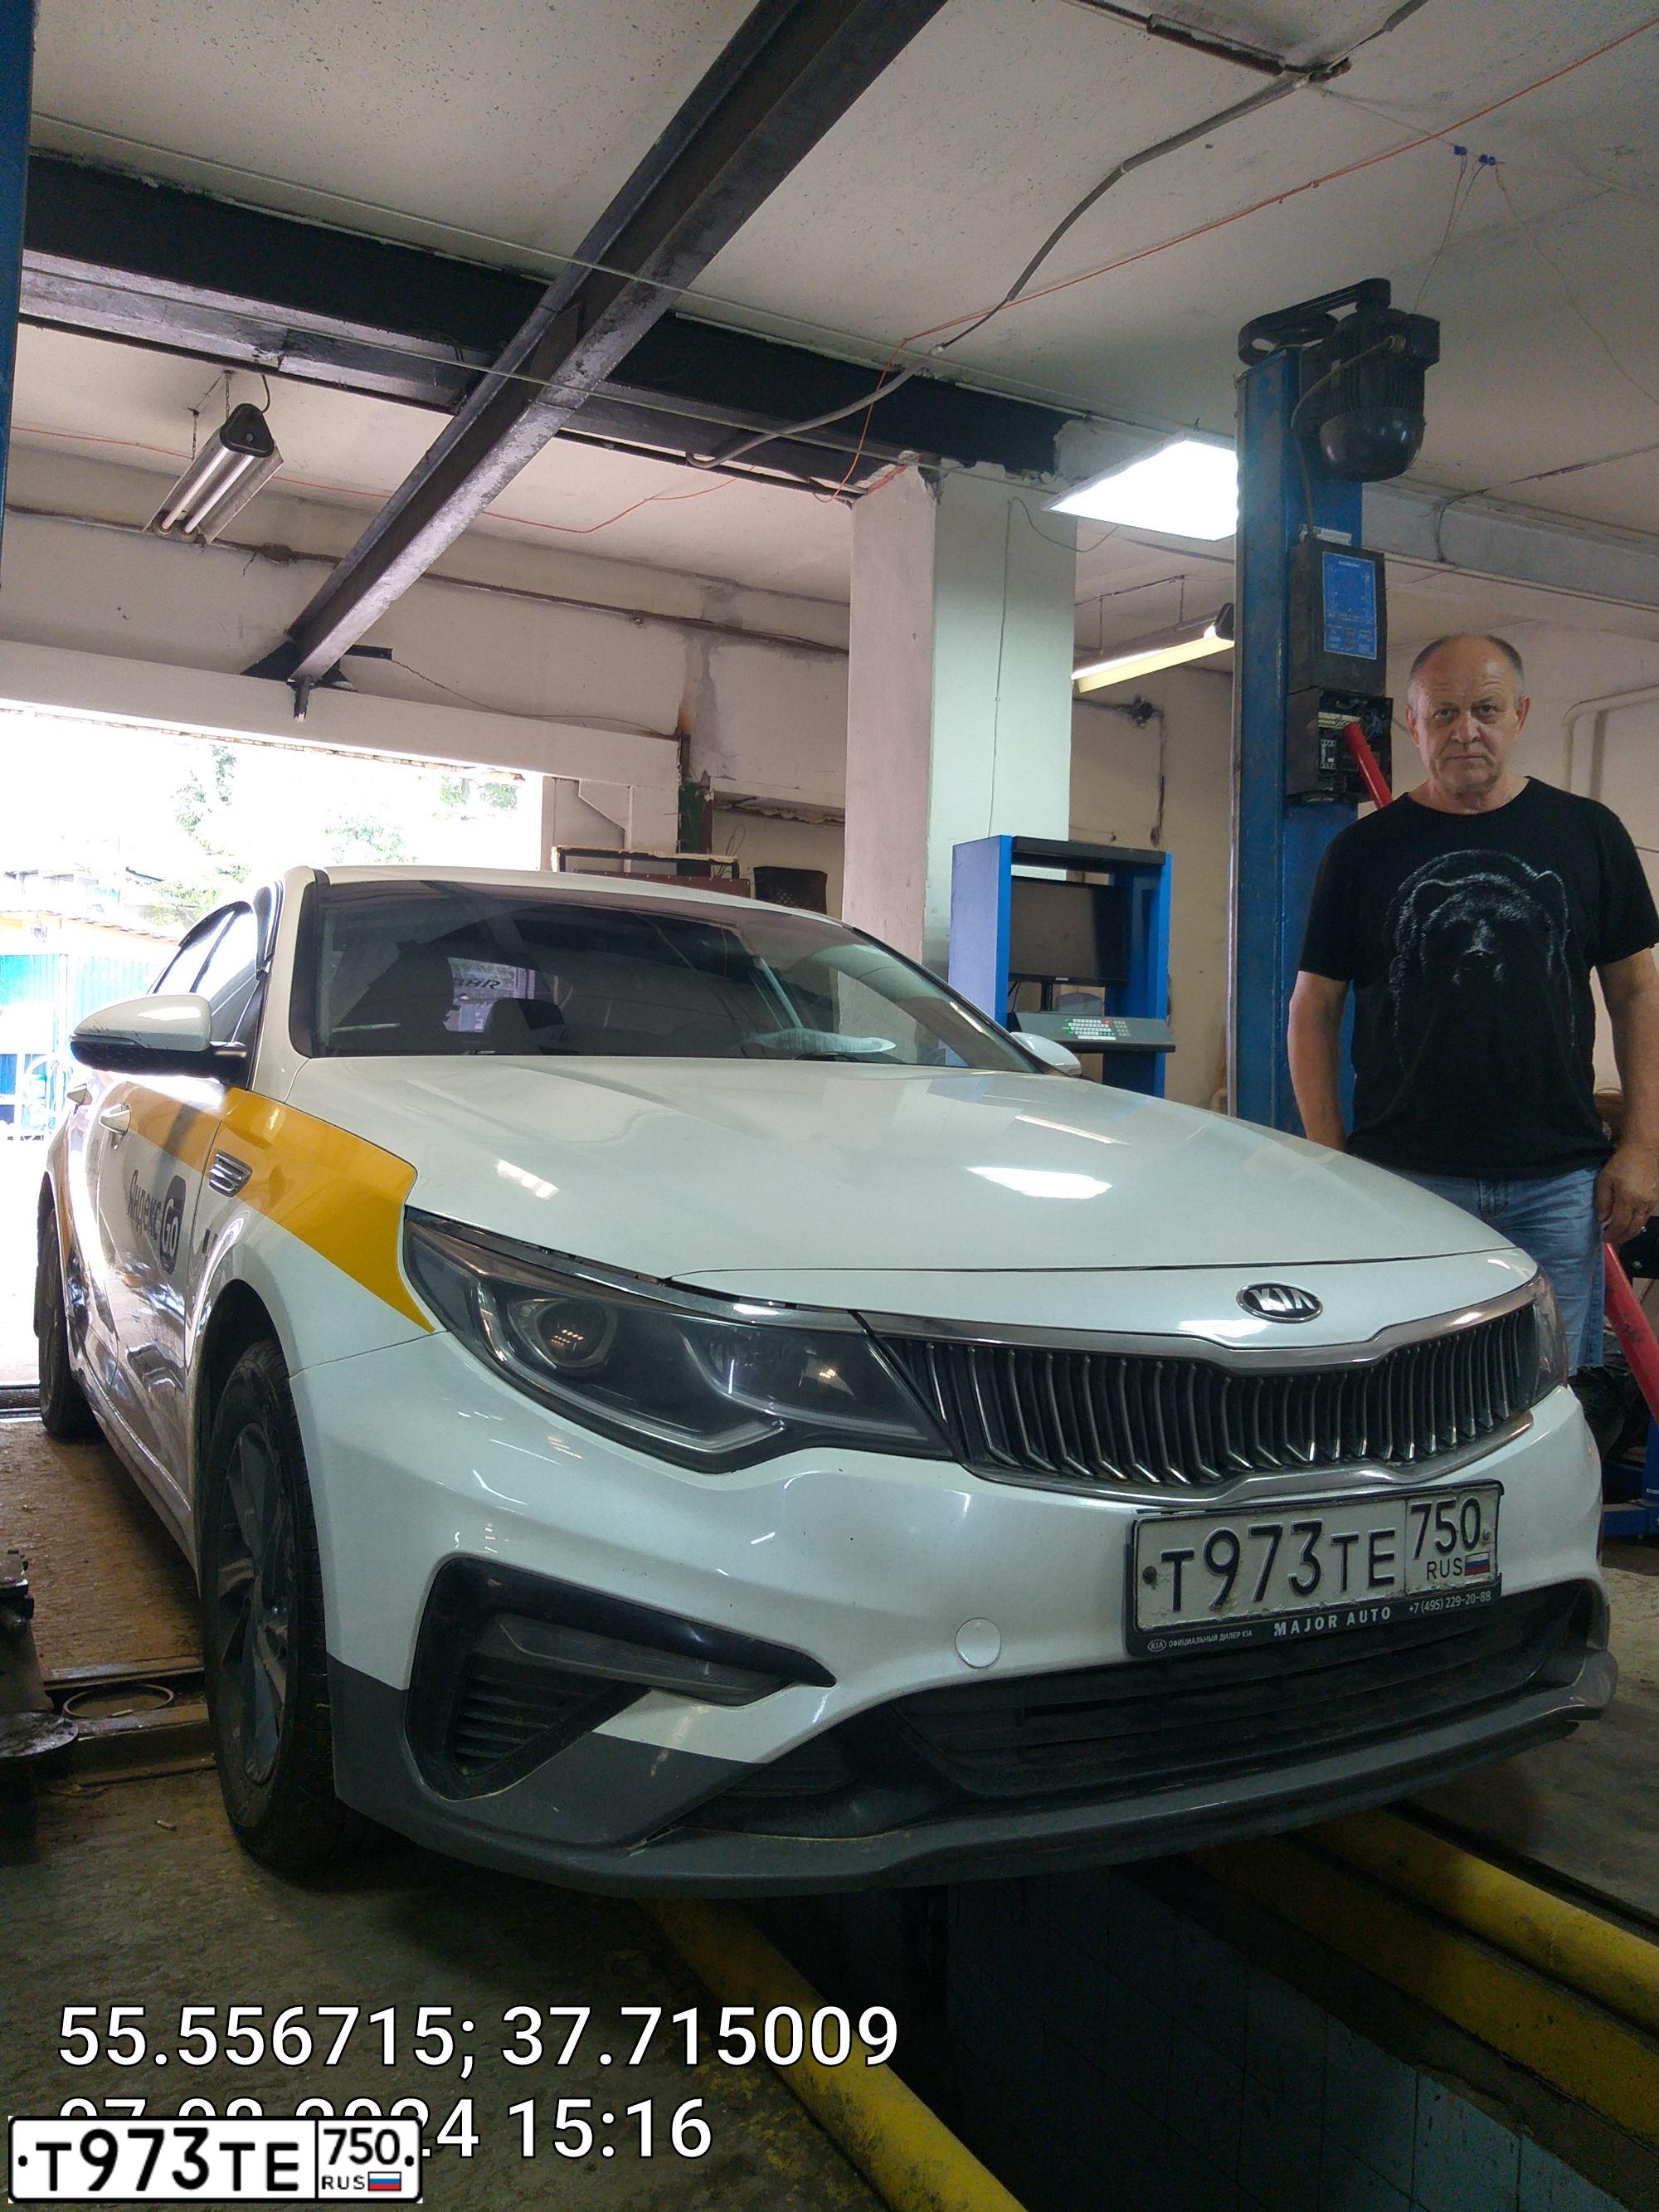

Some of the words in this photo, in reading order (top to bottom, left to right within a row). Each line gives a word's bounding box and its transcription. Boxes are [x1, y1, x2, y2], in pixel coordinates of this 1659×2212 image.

[162, 1197, 180, 1258] Go
[1409, 1496, 1481, 1559] 750
[1426, 1557, 1462, 1581] RUS
[1409, 1602, 1419, 1613] +7
[1420, 1598, 1444, 1614] (495)
[1445, 1591, 1491, 1608] 229-20-88
[1273, 1615, 1338, 1637] MAJOR
[1345, 1606, 1391, 1626] AUTO
[1168, 1634, 1219, 1648] ОФИЦИАЛЬНЫЙ
[1219, 1631, 1241, 1642] ДИЛЕР
[1242, 1630, 1253, 1638] KIA
